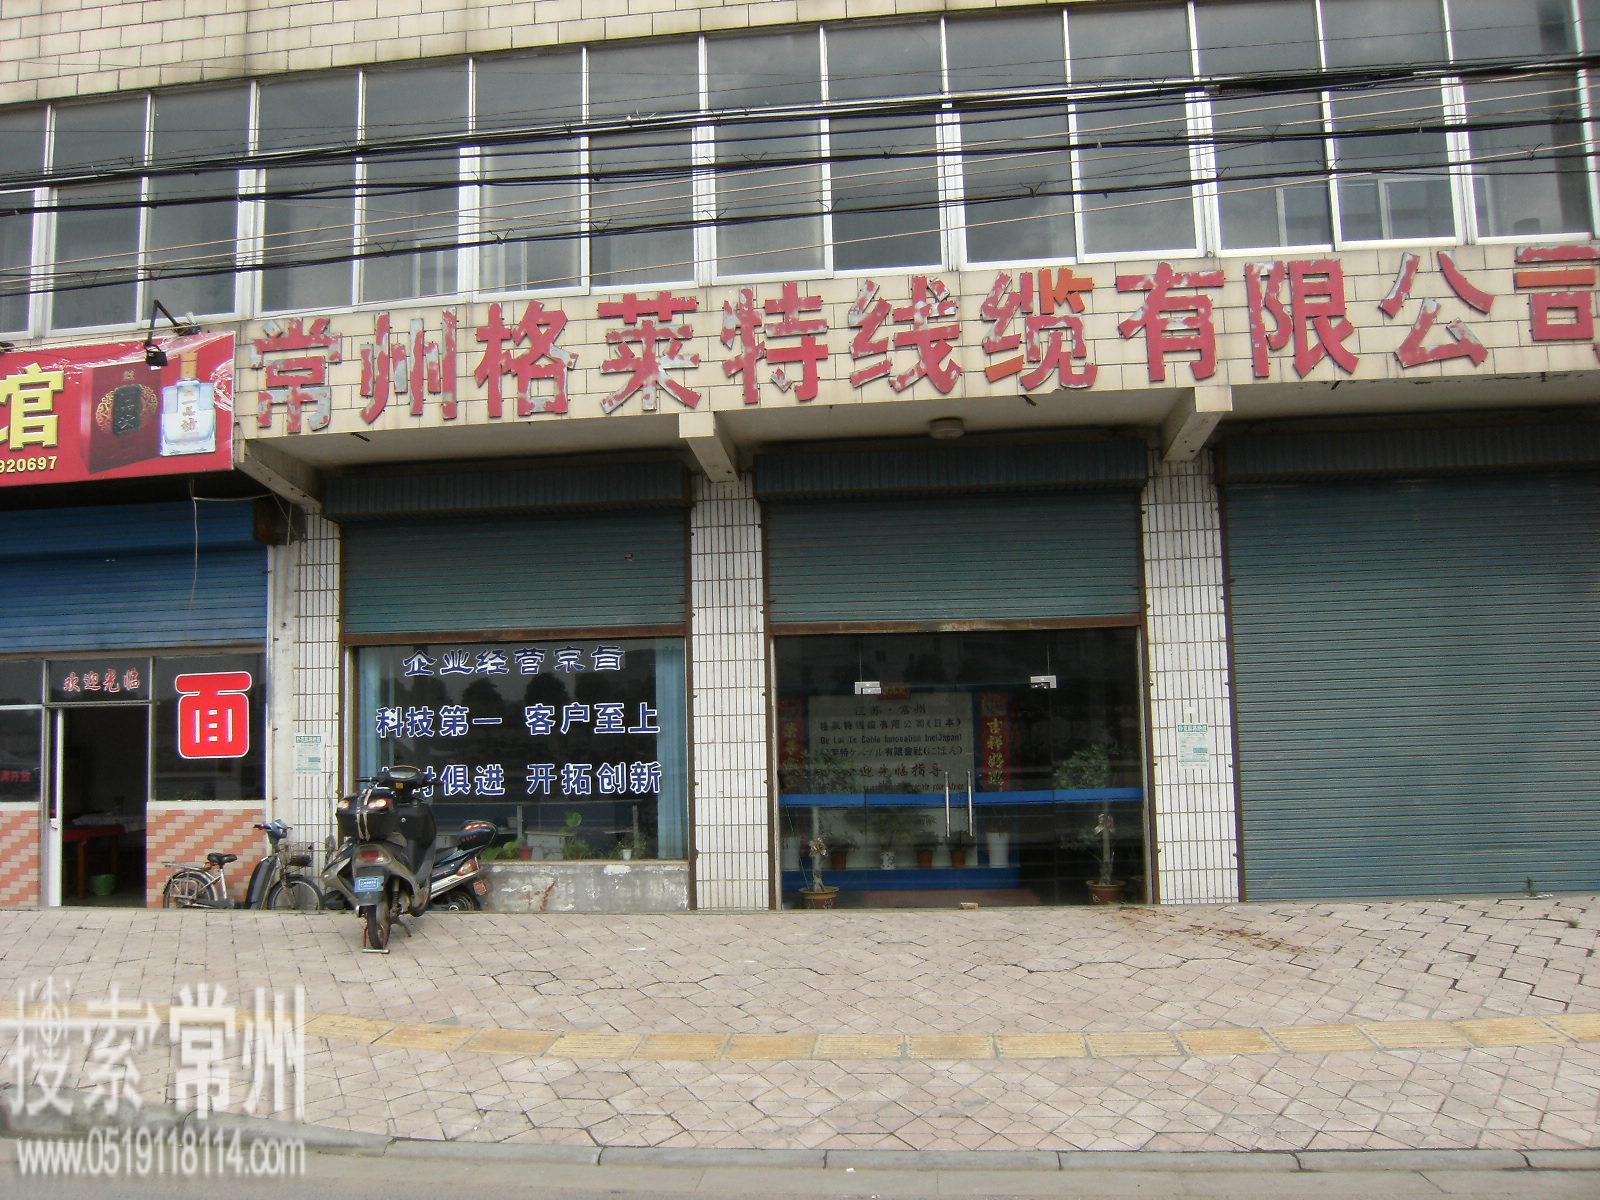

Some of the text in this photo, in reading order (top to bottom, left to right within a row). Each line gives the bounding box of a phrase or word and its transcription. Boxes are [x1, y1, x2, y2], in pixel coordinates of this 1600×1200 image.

[250, 246, 1600, 432] 常州格莱特线缆有限公司
[403, 645, 626, 677] 企业经营宗旨
[64, 668, 140, 692] 欢迎光临
[175, 671, 252, 759] 面
[376, 702, 660, 738] 科技第一 客户至上
[527, 761, 662, 795] 开拓创新
